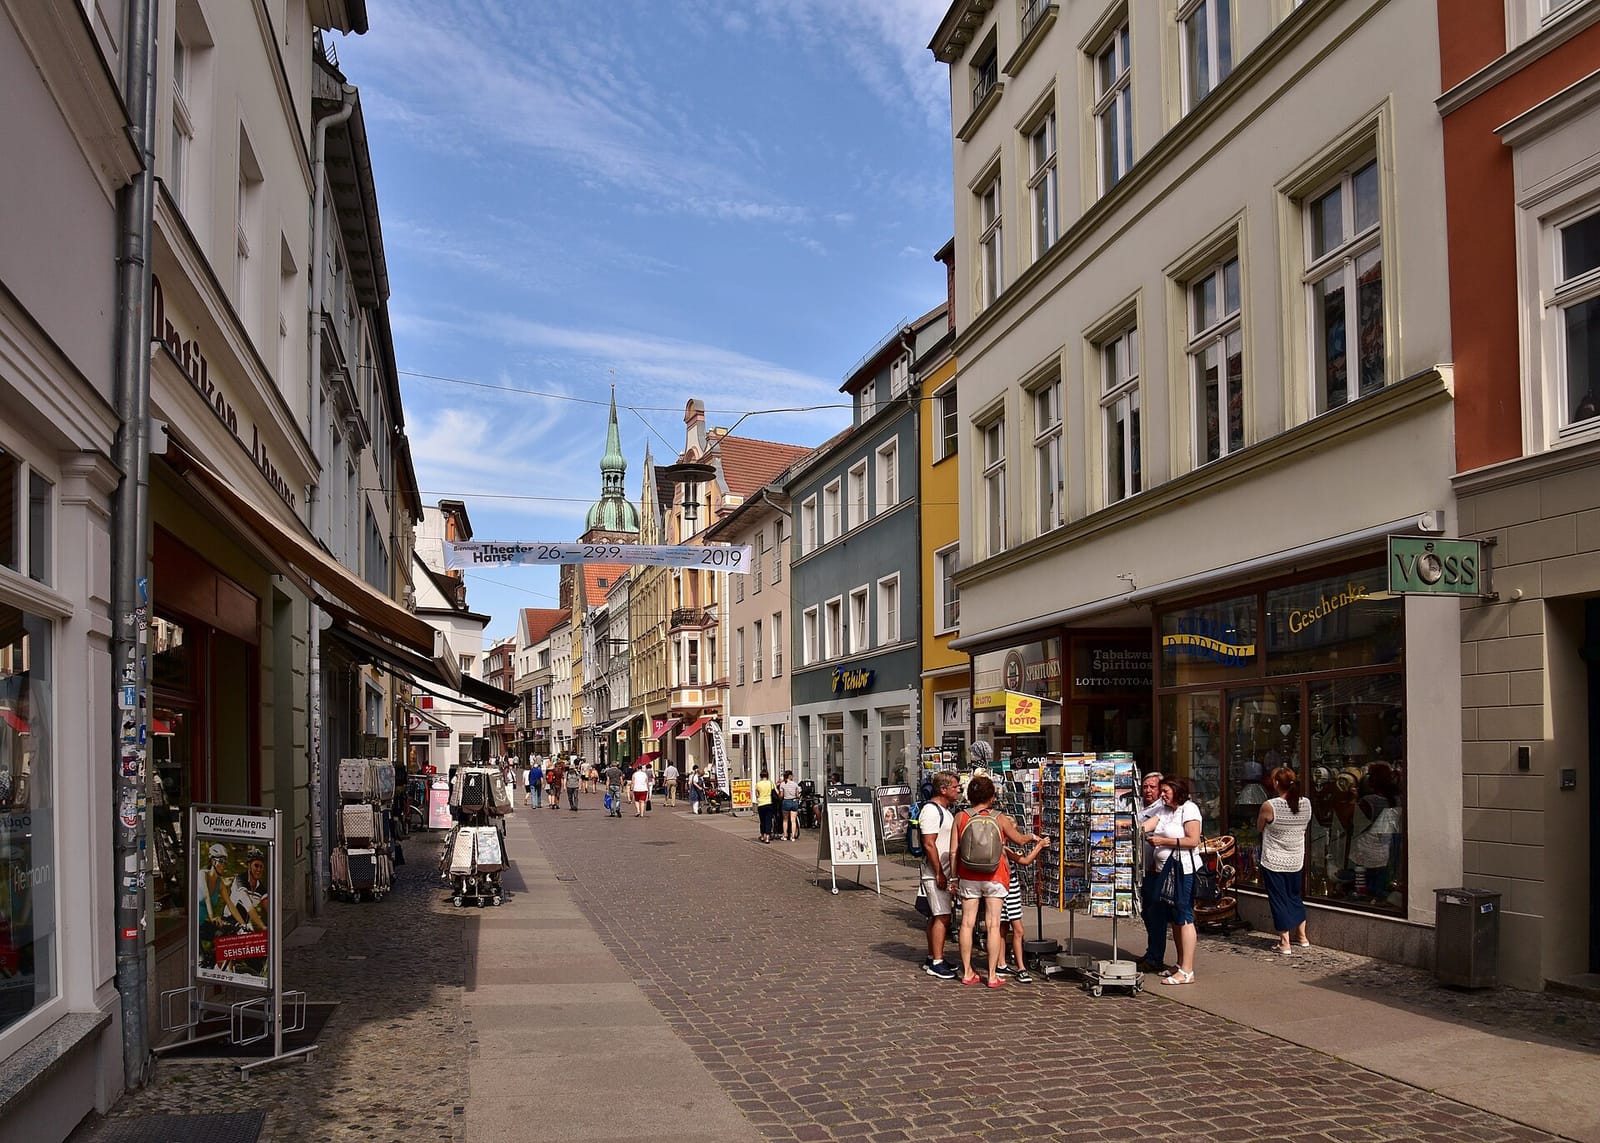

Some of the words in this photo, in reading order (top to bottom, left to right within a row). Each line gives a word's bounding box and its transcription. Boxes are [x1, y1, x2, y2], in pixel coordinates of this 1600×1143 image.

[473, 552, 514, 563] Hanse
[481, 544, 534, 555] Theater
[701, 548, 742, 567] 2019
[1394, 552, 1477, 585] VOSS
[1288, 580, 1368, 634] Geschenke
[842, 667, 870, 692] Tchibo
[1009, 716, 1037, 725] LOTTO
[714, 730, 727, 788] BIRKENSTOCK
[203, 815, 233, 827] Optiker
[235, 818, 267, 829] Ahrens
[223, 945, 266, 958] SEHSTÄRKE
